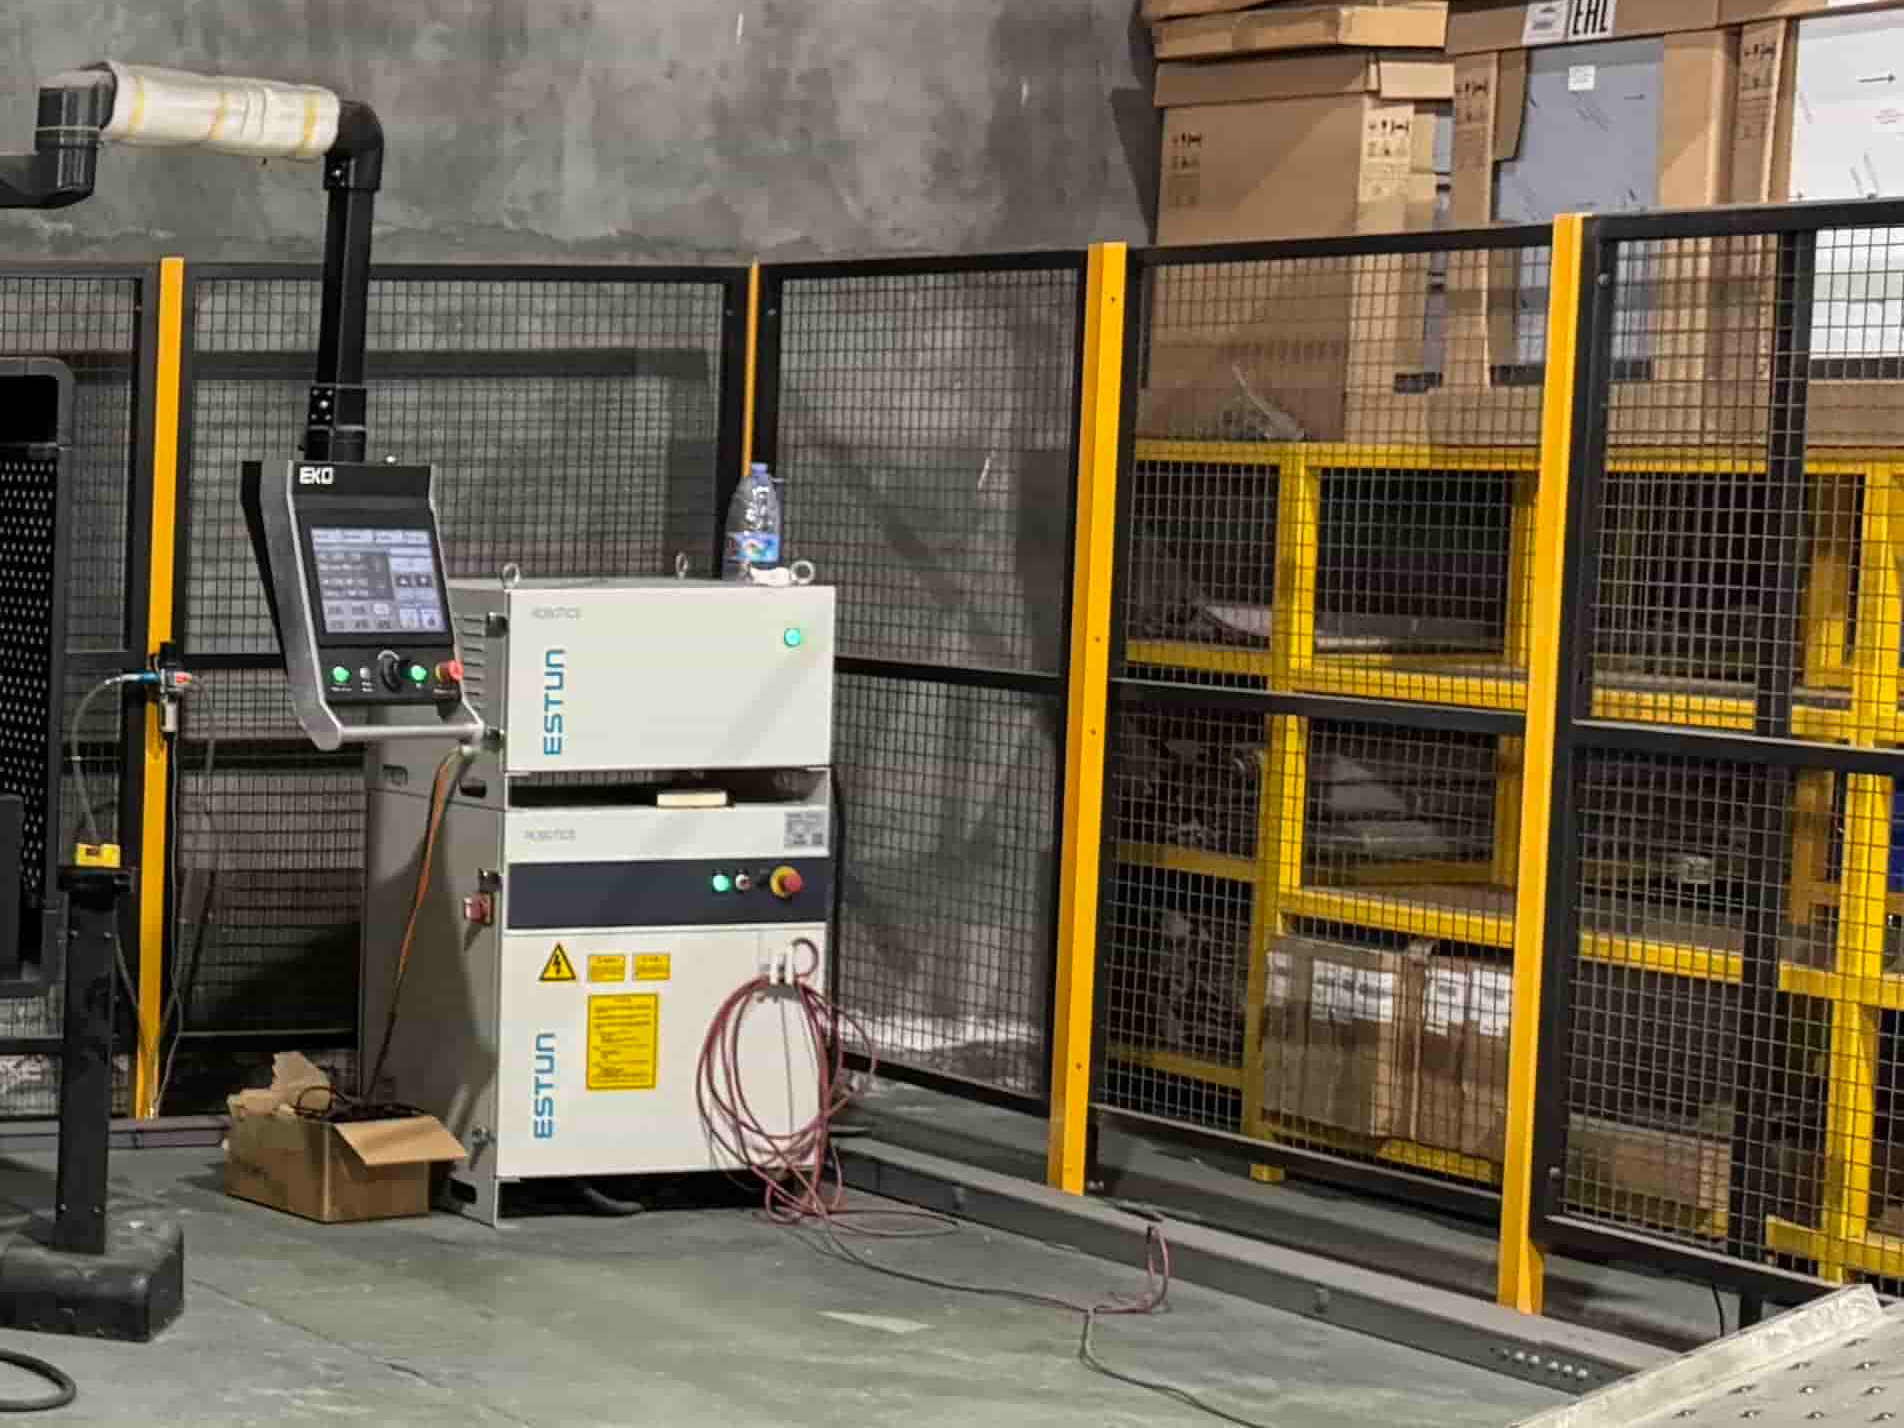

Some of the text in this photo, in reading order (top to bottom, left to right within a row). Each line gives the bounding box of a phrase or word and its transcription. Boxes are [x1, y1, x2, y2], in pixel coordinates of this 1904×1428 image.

[298, 467, 334, 485] EKO
[543, 649, 565, 756] ESTUN
[534, 1033, 556, 1138] ESTUN
